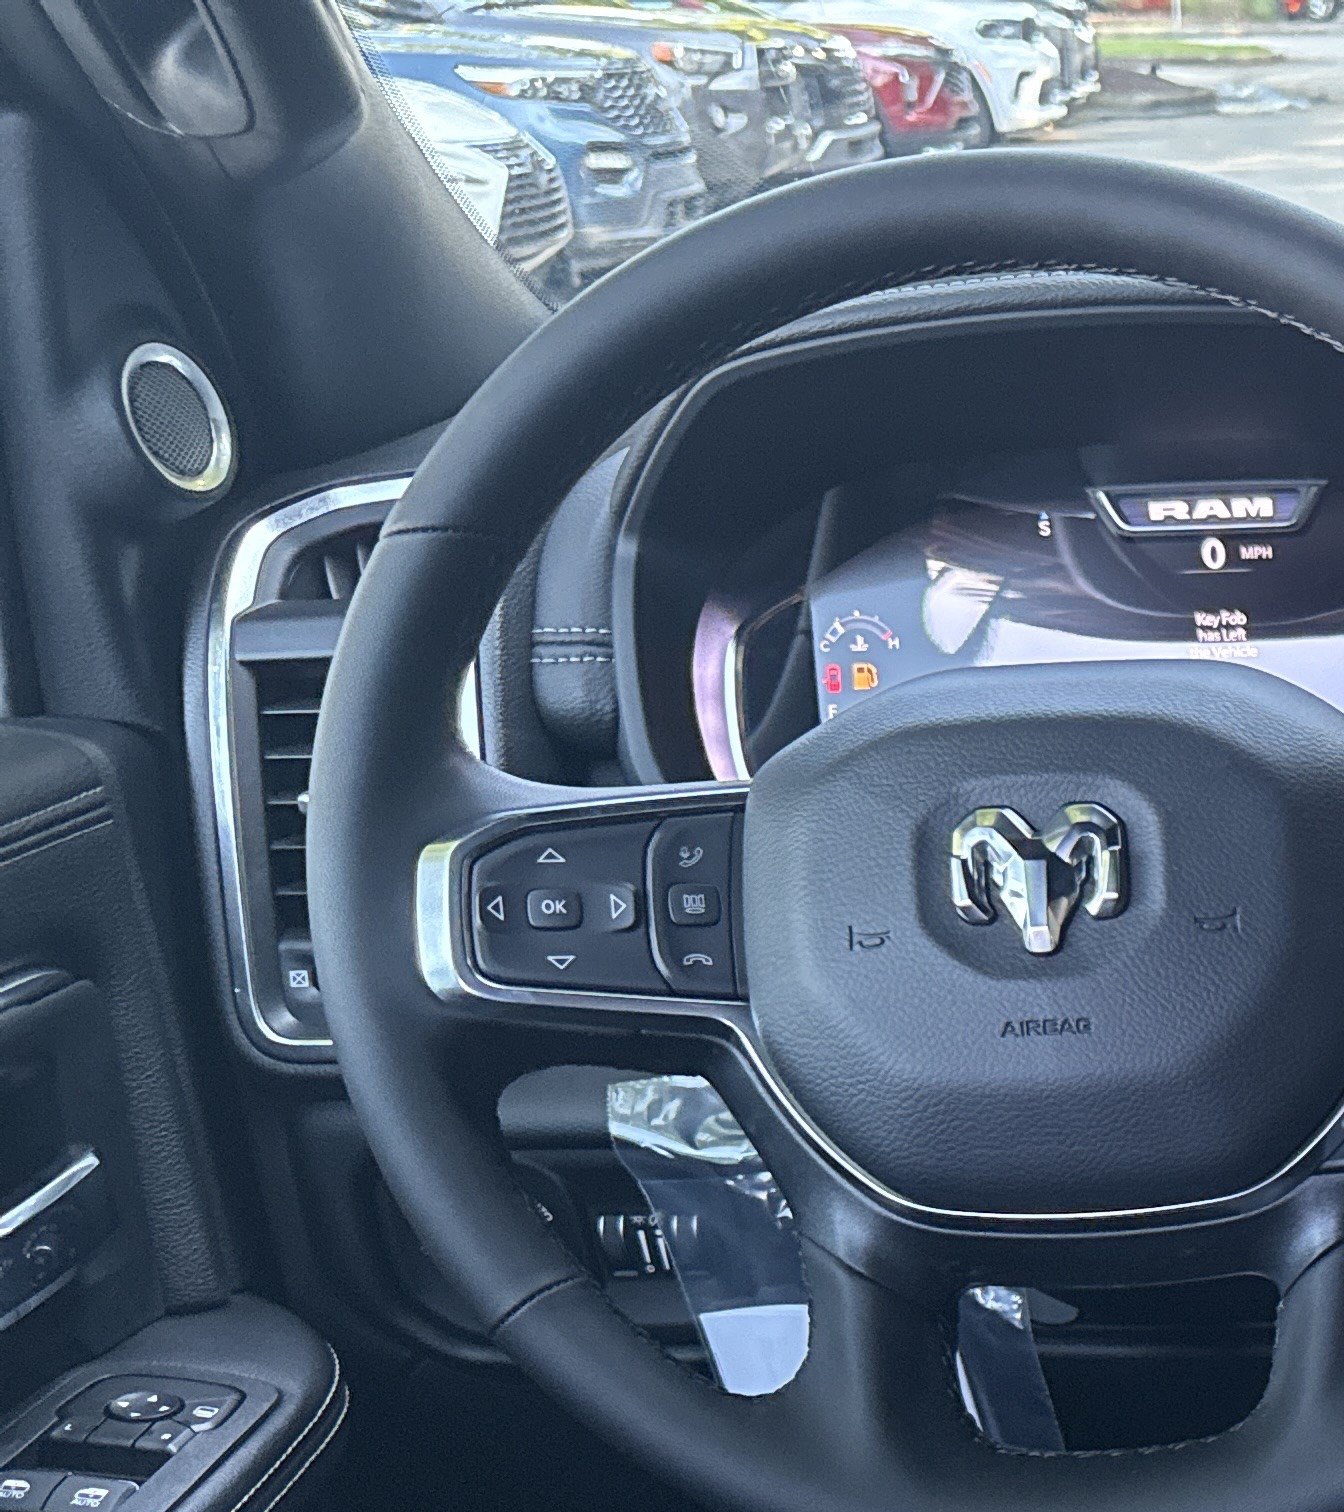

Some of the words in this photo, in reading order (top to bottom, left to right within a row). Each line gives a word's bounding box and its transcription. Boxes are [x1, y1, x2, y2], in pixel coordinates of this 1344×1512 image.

[1147, 496, 1274, 521] RAM
[1201, 537, 1226, 570] 0
[1240, 544, 1273, 561] MPH
[1194, 611, 1220, 628] Key
[1220, 609, 1248, 626] Fob
[1196, 627, 1221, 642] has
[1221, 627, 1248, 642] Left
[1211, 645, 1259, 659] Vehicle
[541, 899, 567, 916] OK
[1000, 1016, 1093, 1038] AIRBAG
[70, 1498, 101, 1508] AUTO
